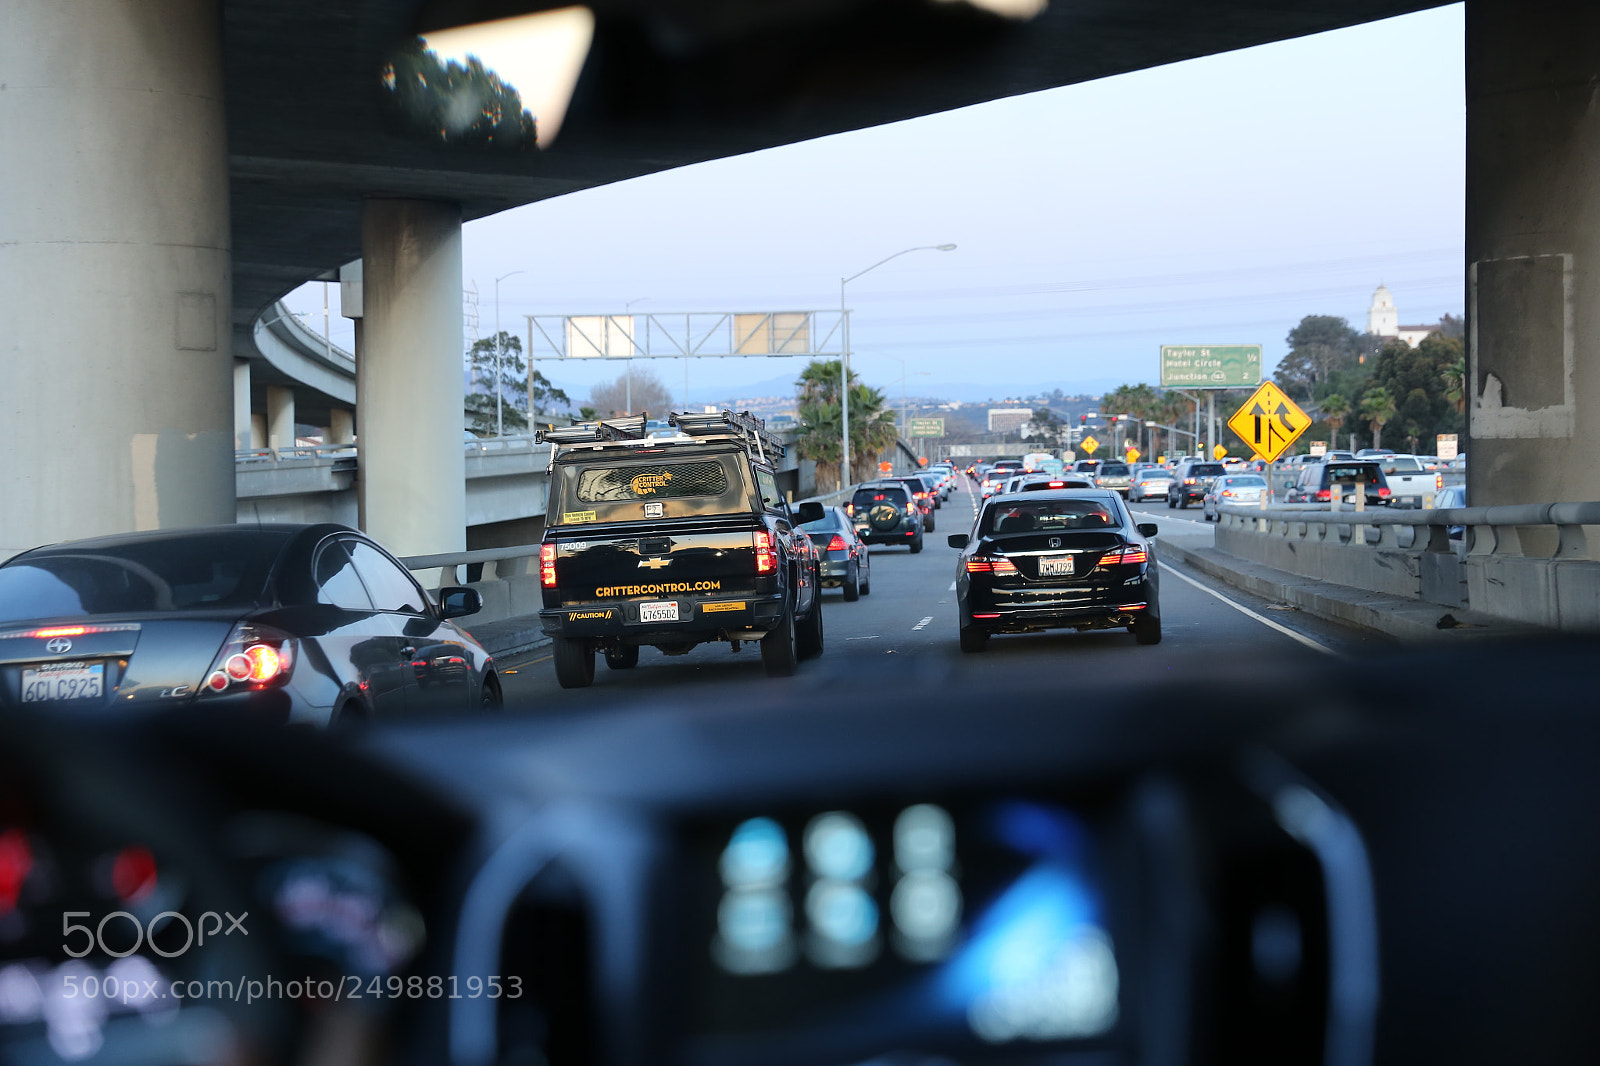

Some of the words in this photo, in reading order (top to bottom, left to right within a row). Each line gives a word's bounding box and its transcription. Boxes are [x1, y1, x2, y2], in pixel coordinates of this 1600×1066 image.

[1166, 349, 1196, 359] Taylor
[1200, 348, 1211, 357] St
[1166, 359, 1191, 367] Hotel
[1194, 359, 1222, 367] Circle
[1167, 373, 1208, 381] Junction
[560, 541, 587, 551] 75009
[595, 580, 721, 597] CRITTERCONTROL.COM
[576, 611, 605, 620] CAUTION
[25, 677, 99, 701] 6CLC925
